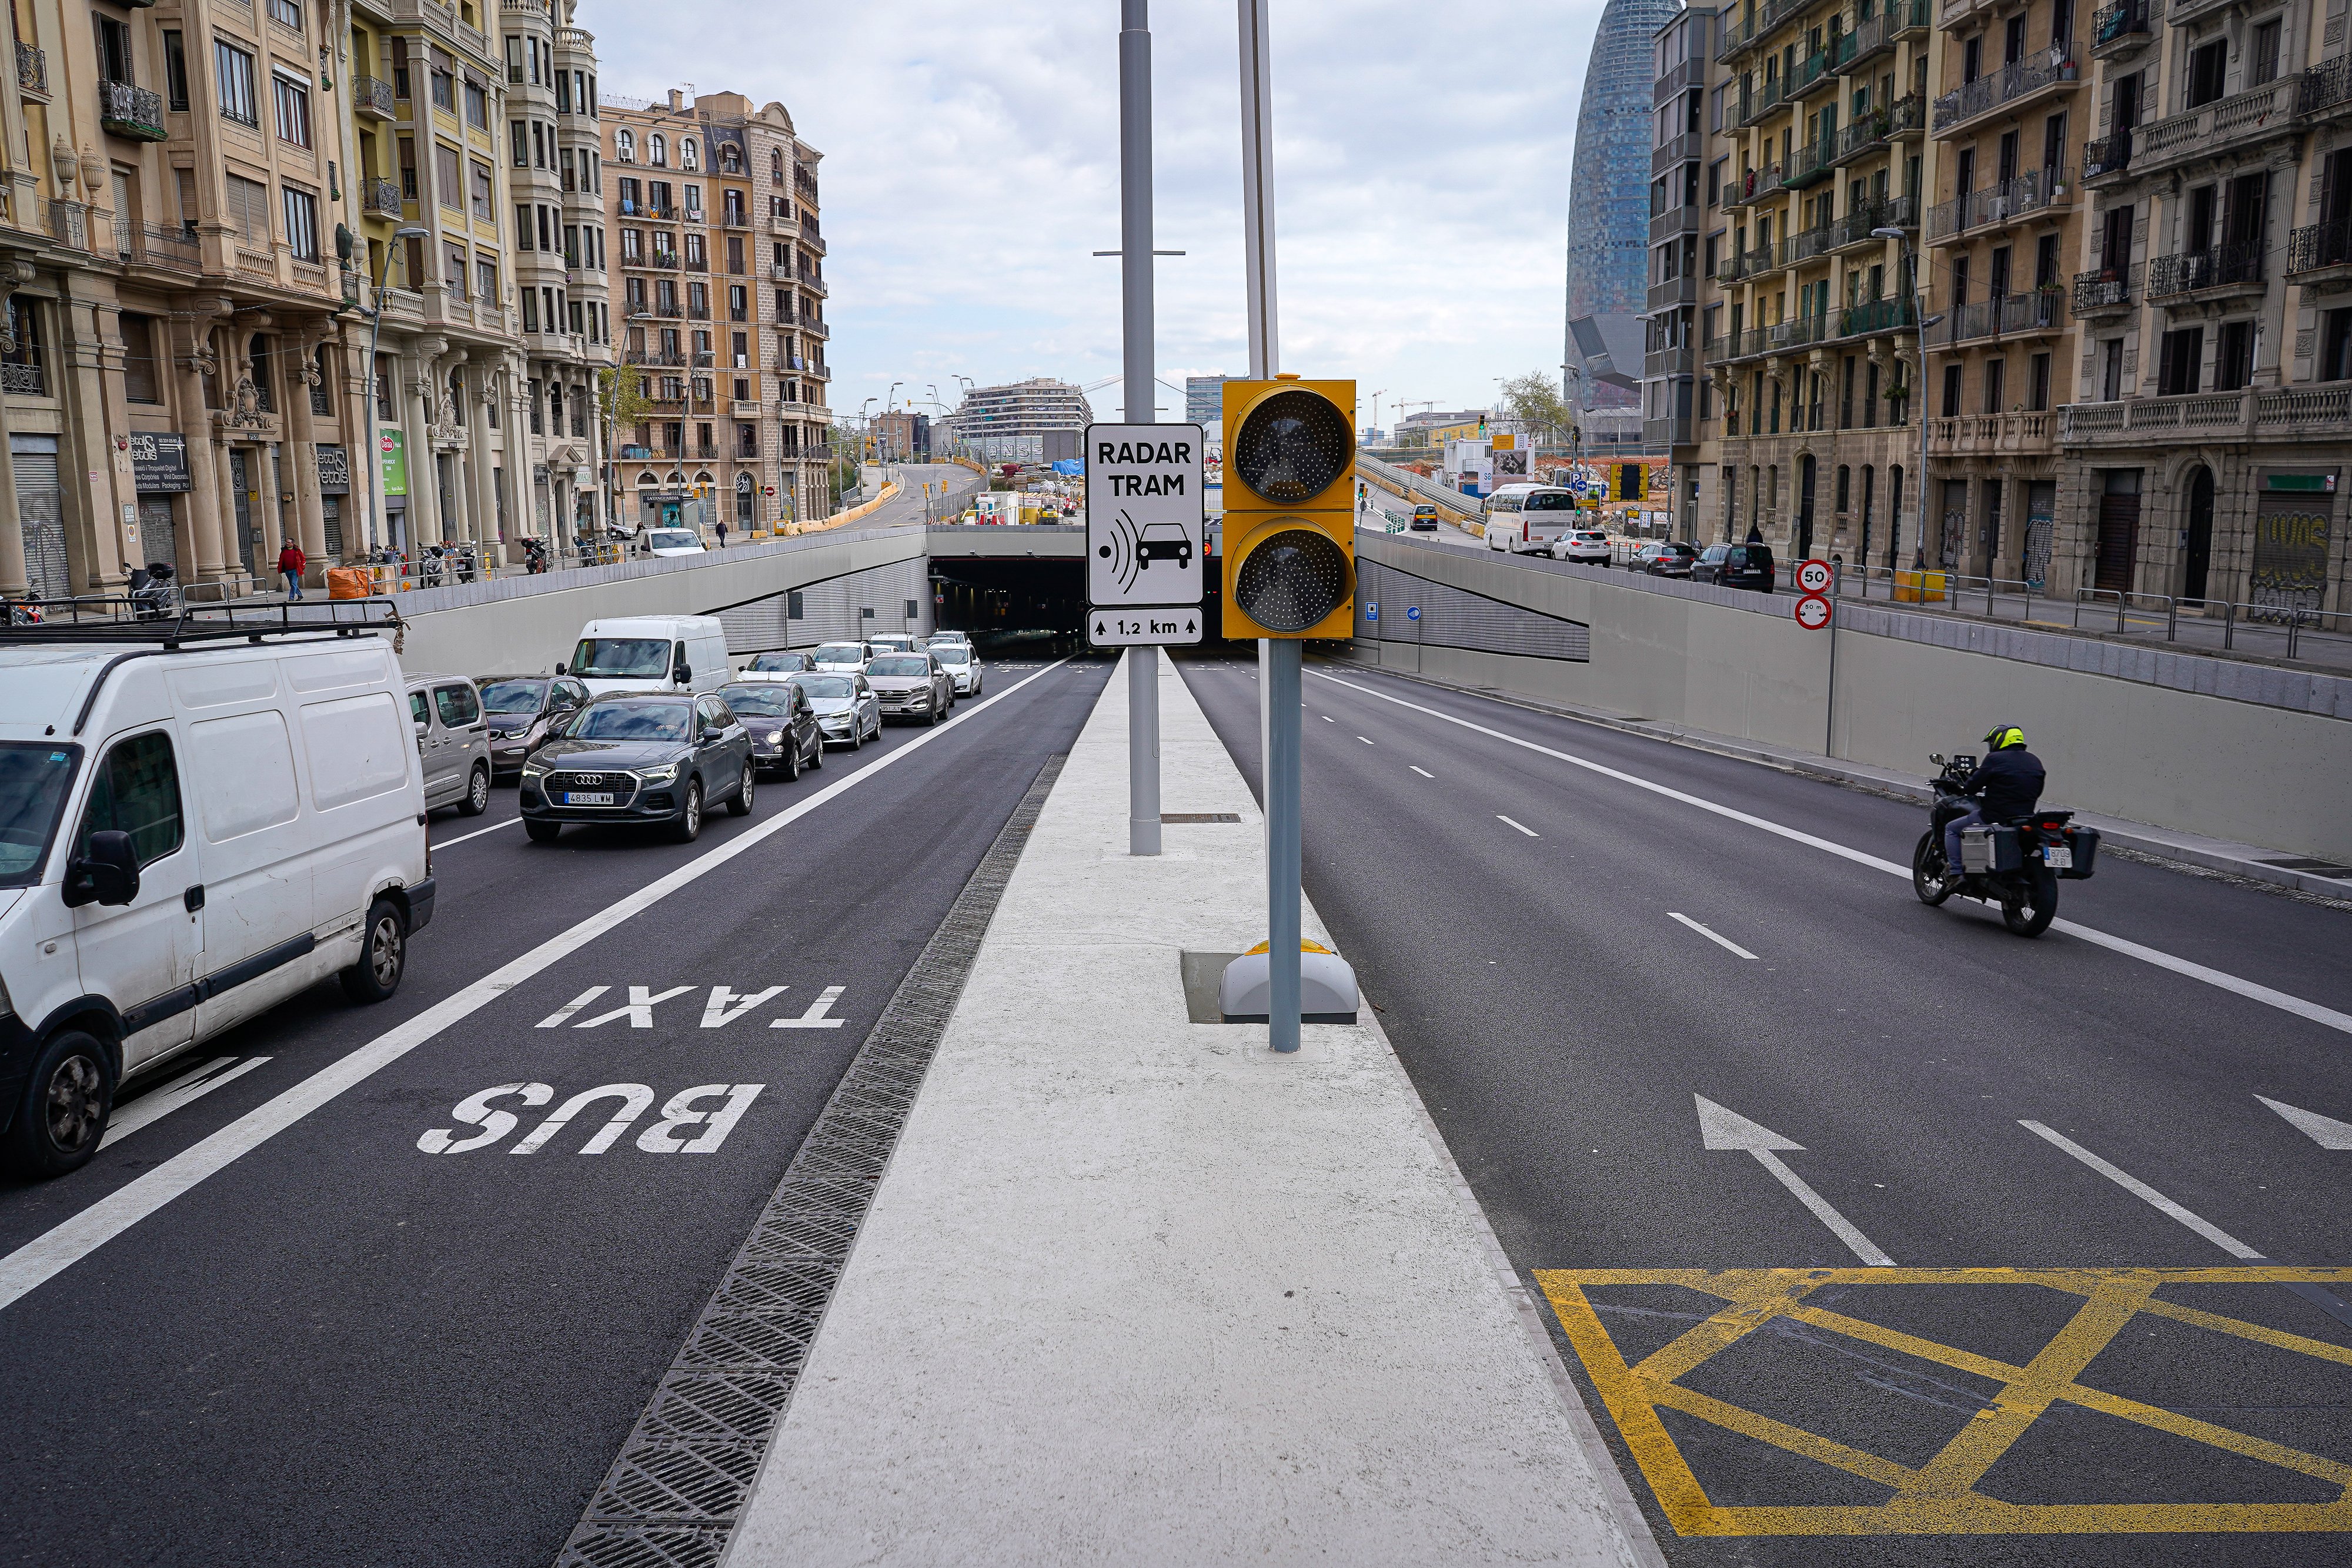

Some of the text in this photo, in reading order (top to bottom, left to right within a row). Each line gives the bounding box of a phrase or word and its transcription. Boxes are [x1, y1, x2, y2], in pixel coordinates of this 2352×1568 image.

[381, 439, 392, 448] Daraa
[1098, 442, 1191, 464] RADAR
[165, 464, 176, 473] Digital
[1108, 474, 1184, 497] TRAM
[1572, 474, 1580, 483] P
[1805, 571, 1825, 583] 50
[1117, 619, 1177, 636] 1,2 km
[534, 985, 846, 1028] TAXI
[416, 1082, 766, 1155] BUS
